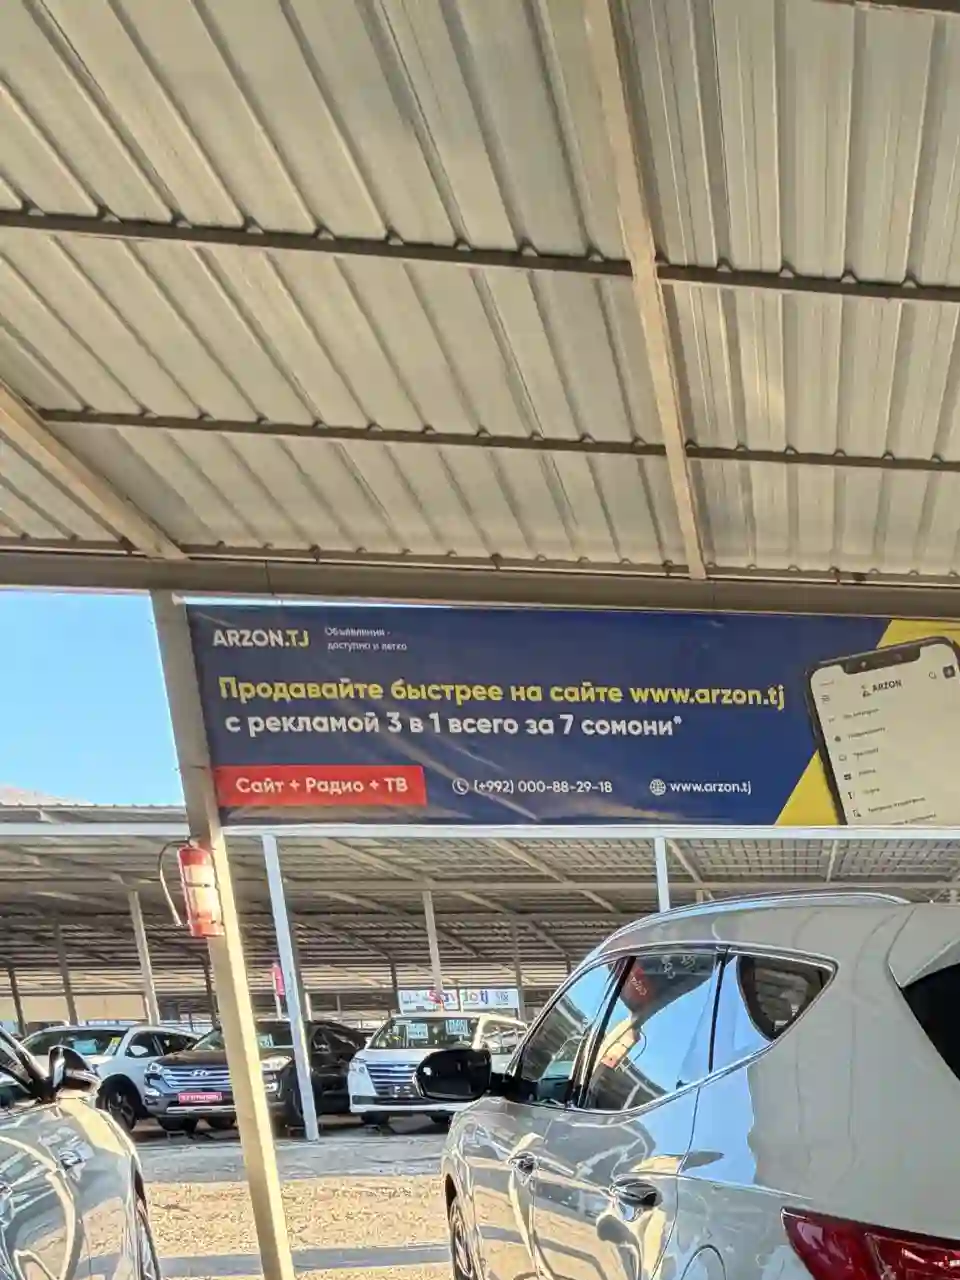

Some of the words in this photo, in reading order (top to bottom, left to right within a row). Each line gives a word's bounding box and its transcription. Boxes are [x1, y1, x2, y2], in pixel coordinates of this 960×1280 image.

[212, 629, 310, 648] ARZON.TJ
[218, 676, 384, 704] Продавайте
[390, 679, 504, 705] быстрее
[510, 683, 542, 702] на
[549, 681, 624, 704] сайте
[629, 683, 786, 711] www.arzon.tj
[225, 716, 241, 732] с
[248, 712, 380, 737] рекламой
[387, 711, 402, 733] 3
[409, 718, 424, 733] в
[428, 712, 440, 733] 1
[448, 717, 519, 735] всего
[525, 717, 555, 735] за
[559, 714, 574, 735] 7
[235, 777, 284, 794] Сайт
[305, 778, 364, 795] Радио
[384, 778, 408, 793] ТВ
[474, 780, 514, 794] (+992)
[518, 780, 613, 794] 000-88-29-18
[670, 780, 752, 795] www.arzon.tj
